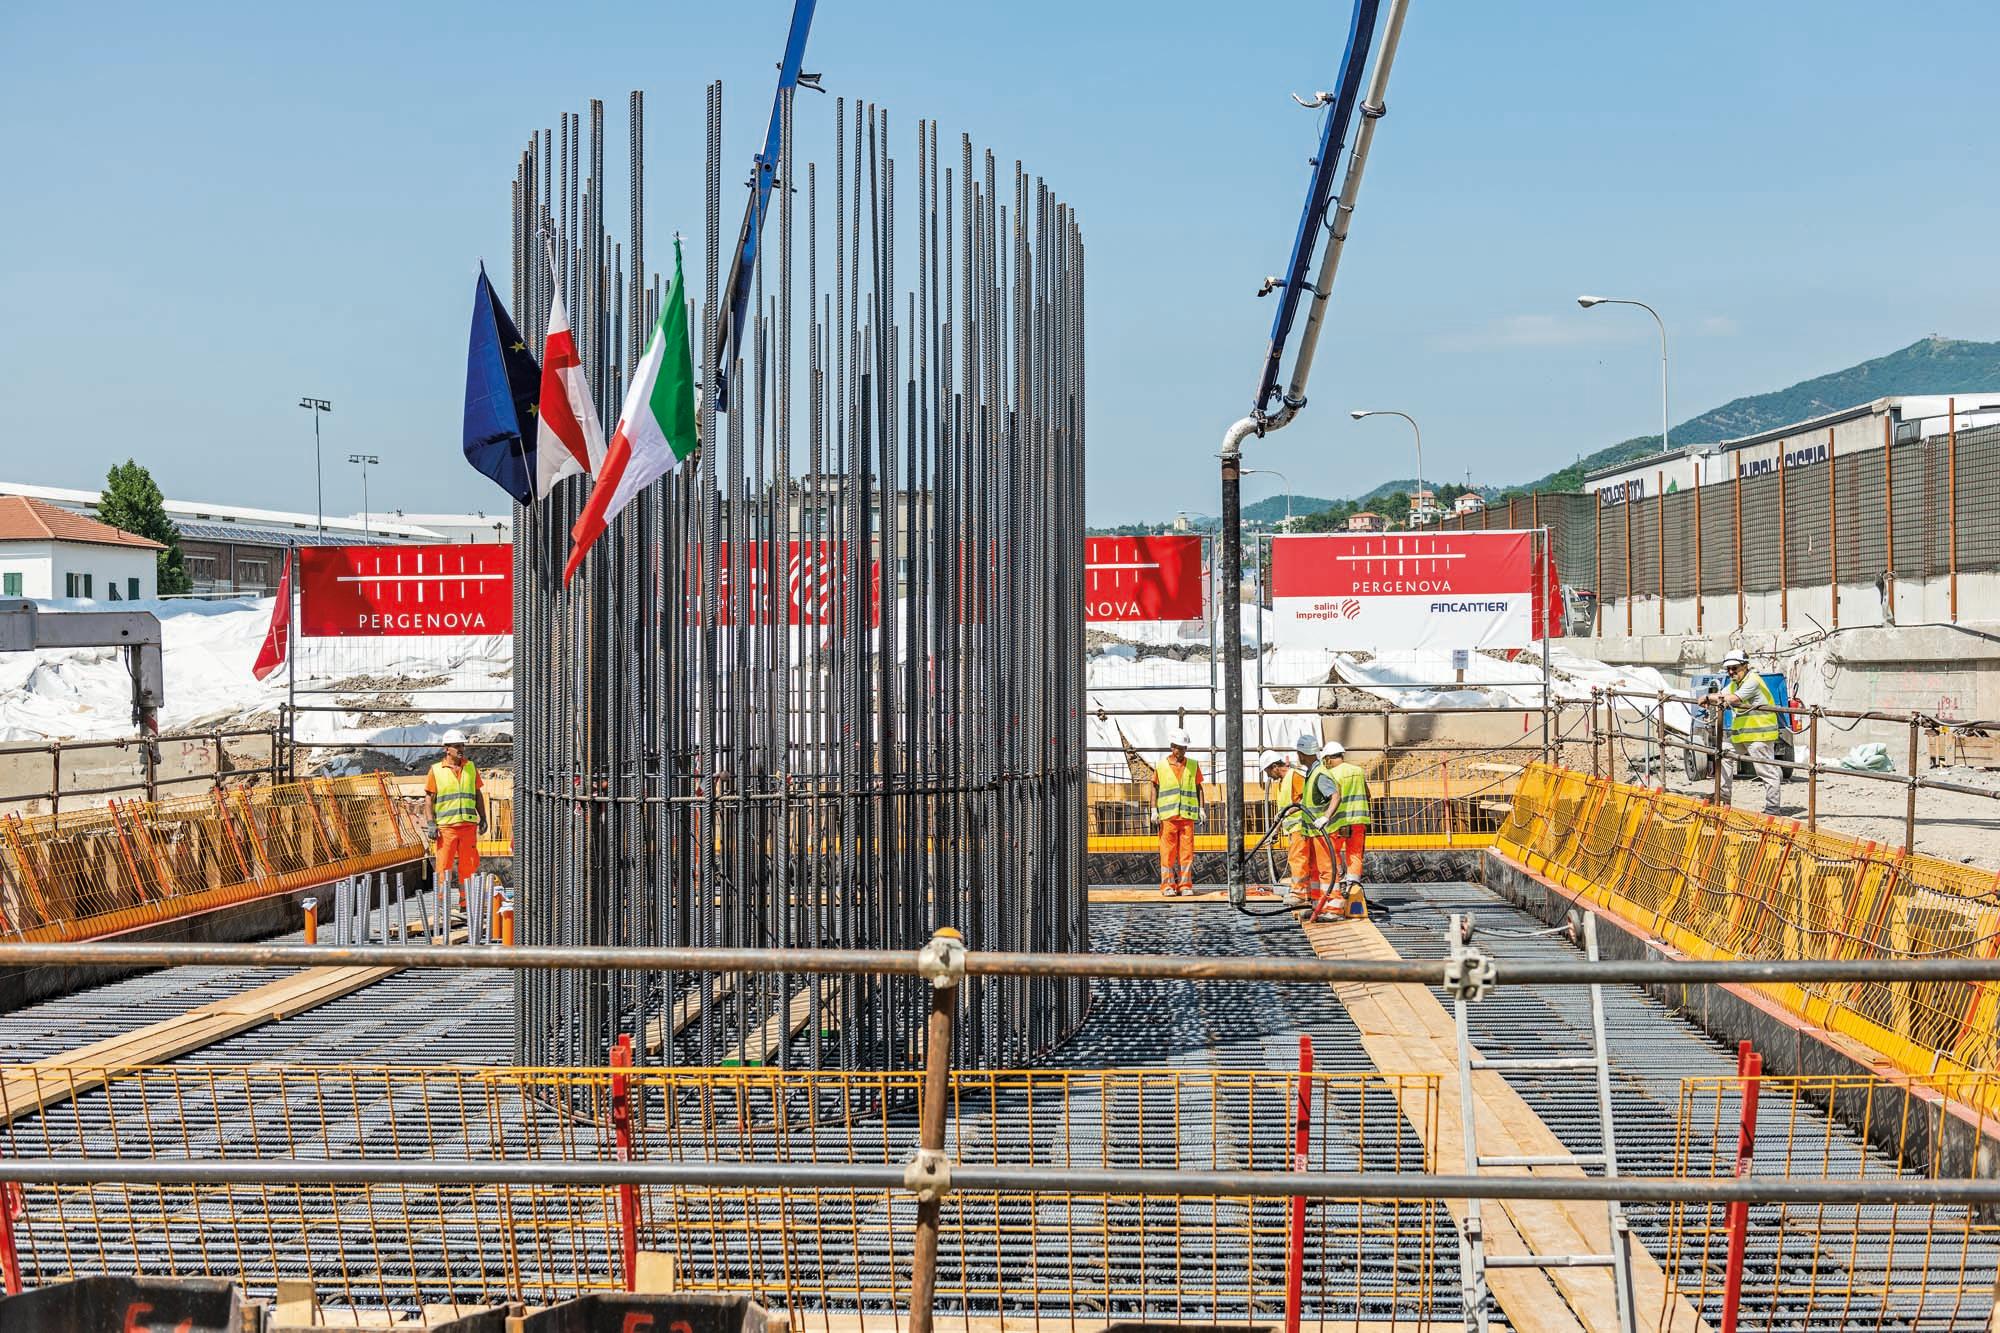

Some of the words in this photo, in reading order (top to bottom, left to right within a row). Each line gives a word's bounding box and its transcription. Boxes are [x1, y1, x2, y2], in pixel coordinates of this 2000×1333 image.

[1353, 580, 1451, 593] PERGENOVA
[1314, 603, 1338, 611] salini
[1430, 602, 1508, 612] FINCANTIERI
[359, 613, 486, 628] PERGENOVA
[1296, 611, 1339, 620] impregilo
